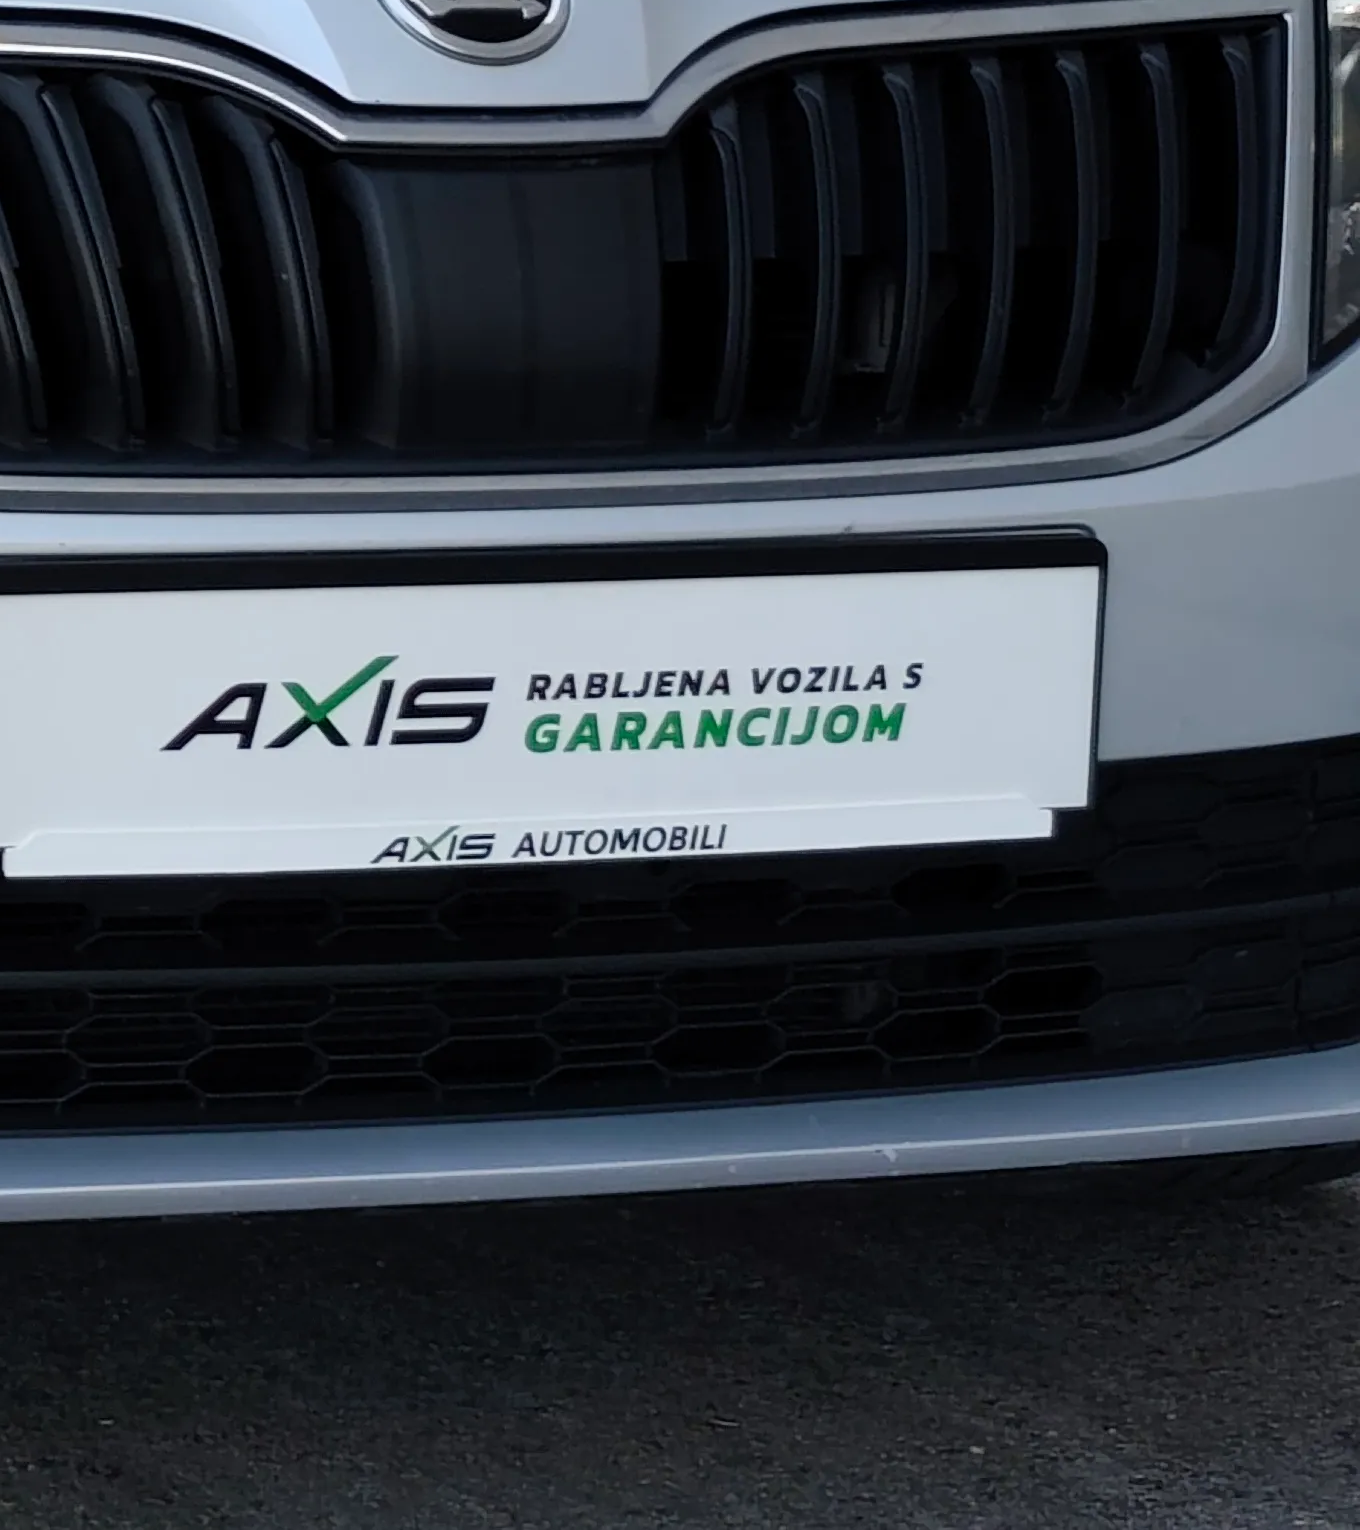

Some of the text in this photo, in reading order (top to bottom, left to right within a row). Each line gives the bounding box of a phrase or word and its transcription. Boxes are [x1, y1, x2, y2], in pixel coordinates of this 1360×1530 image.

[160, 654, 496, 751] AXIS
[525, 662, 925, 702] RABLJENA VOZILA S
[524, 703, 907, 755] GARANCIJOM
[370, 823, 728, 865] AXIS AUTOMOBILI
